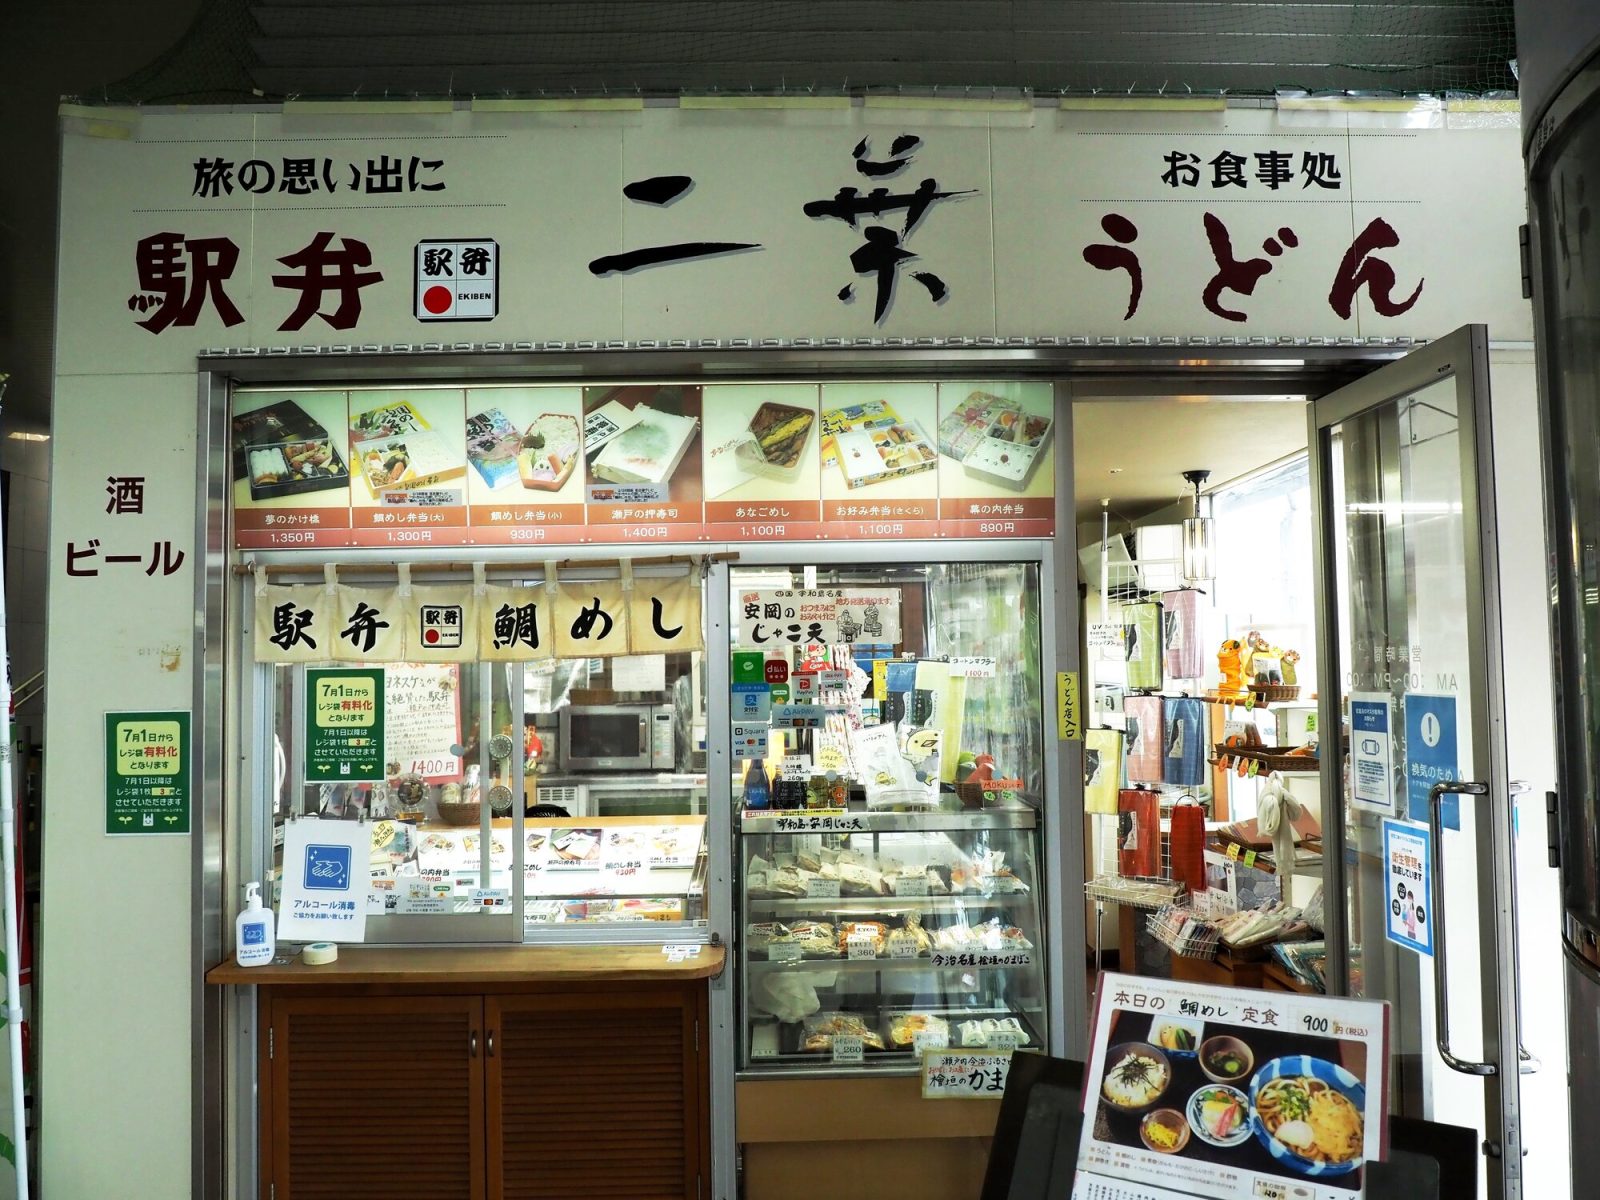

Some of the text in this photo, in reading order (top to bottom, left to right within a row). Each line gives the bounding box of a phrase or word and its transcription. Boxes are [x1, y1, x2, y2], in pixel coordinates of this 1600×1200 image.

[193, 155, 446, 198] 旅の思い出に
[1161, 150, 1342, 191] お食事処
[423, 246, 491, 278] 駅弁
[1083, 212, 1424, 322] うどん
[127, 231, 384, 335] 駅弁
[457, 292, 491, 300] EKIBEN
[105, 476, 145, 515] 酒
[736, 507, 790, 518] あなごめし
[969, 503, 1024, 515] 幕の内弁当
[623, 527, 667, 538] 1,400円
[740, 525, 785, 537] 1,100円
[859, 524, 903, 535] 1,100円
[980, 522, 1015, 534] 890円
[270, 533, 315, 543] 1,350円
[387, 531, 432, 541] 1,300円
[510, 529, 545, 540] 930円
[66, 539, 185, 577] ビール
[425, 609, 458, 625] 駅弁
[744, 603, 796, 620] 安岡の
[269, 602, 390, 653] 駅弁
[492, 597, 684, 650] 鯛めし
[752, 623, 826, 644] じゃこ天
[322, 684, 369, 697] 7月1日から
[319, 700, 373, 712] レジ袋有料化
[1063, 675, 1077, 738] うどん店入口
[328, 714, 365, 722] となります
[123, 729, 174, 742] 7月1日から
[120, 746, 178, 758] レジ袋有料化
[314, 748, 377, 756] させていただきます
[130, 761, 169, 769] となります
[411, 760, 455, 774] 1400円
[1411, 762, 1453, 782] 換気のため
[125, 777, 172, 785] 7月1日以降は
[115, 799, 182, 807] させていただきます
[293, 900, 356, 911] アルコール消毒
[1113, 991, 1166, 1010] 本日の
[1178, 998, 1229, 1017] 鯛めし
[1241, 1007, 1279, 1026] 定食
[1303, 1015, 1329, 1033] 900
[844, 1045, 862, 1053] 260
